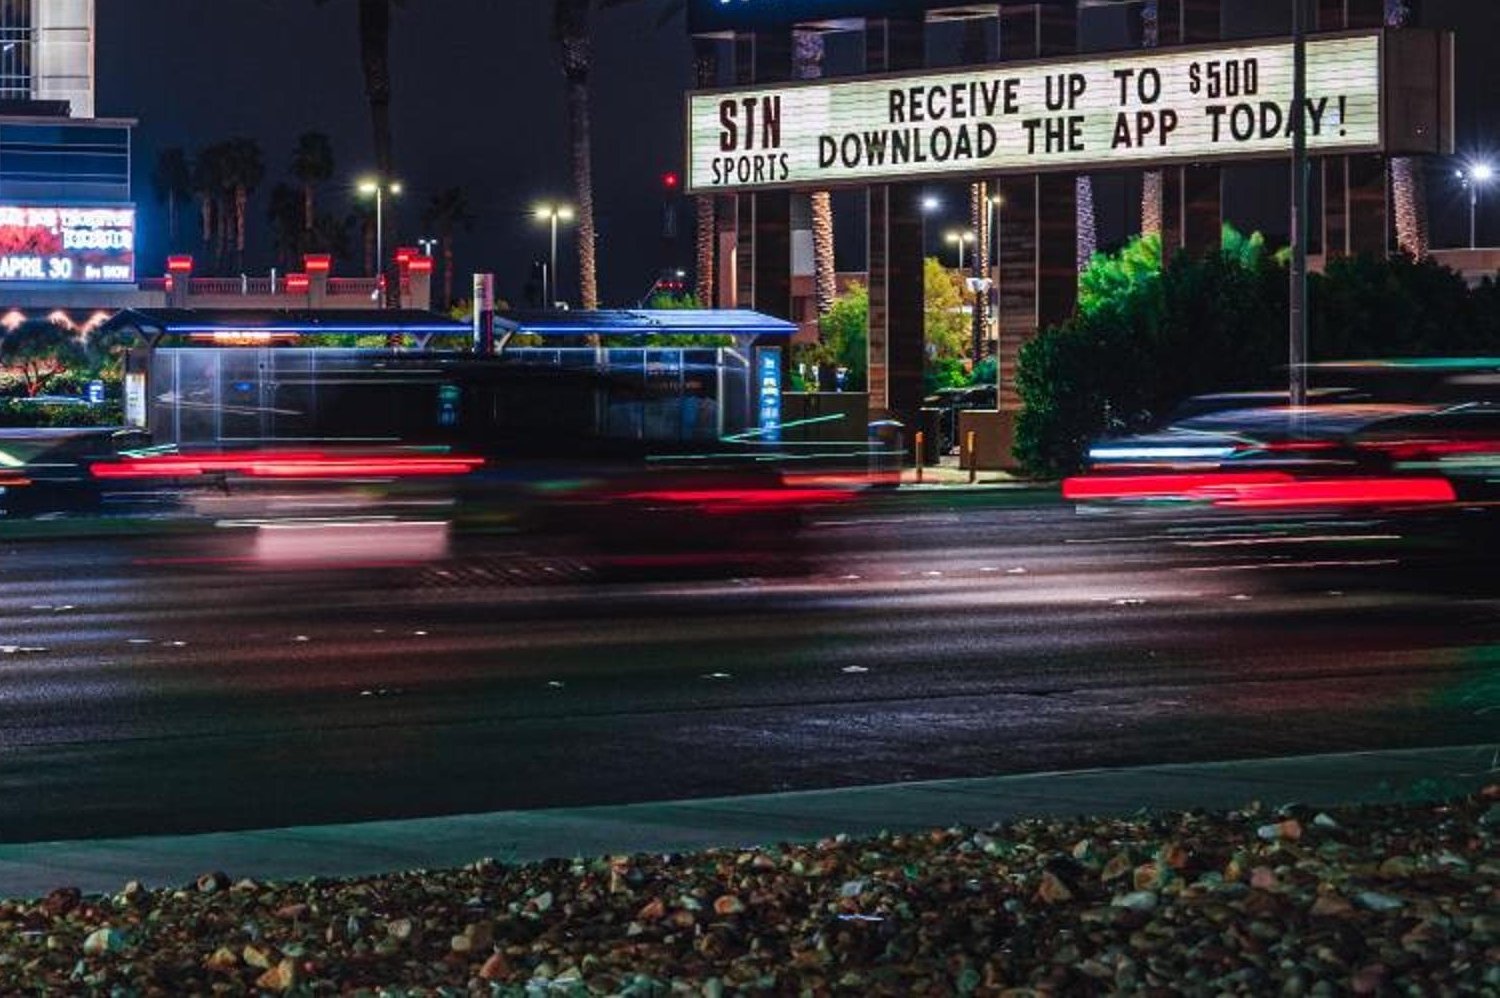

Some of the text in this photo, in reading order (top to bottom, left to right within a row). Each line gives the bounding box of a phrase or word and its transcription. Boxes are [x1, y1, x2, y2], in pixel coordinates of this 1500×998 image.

[888, 57, 1258, 123] RECEIVE UP TO $500
[719, 95, 781, 152] STN
[818, 122, 998, 169] DOWNLOAD
[1022, 115, 1086, 154] THE
[1111, 108, 1179, 149] APP
[711, 153, 789, 185] SPORTS
[0, 256, 46, 279] APRIL
[49, 256, 72, 279] 30
